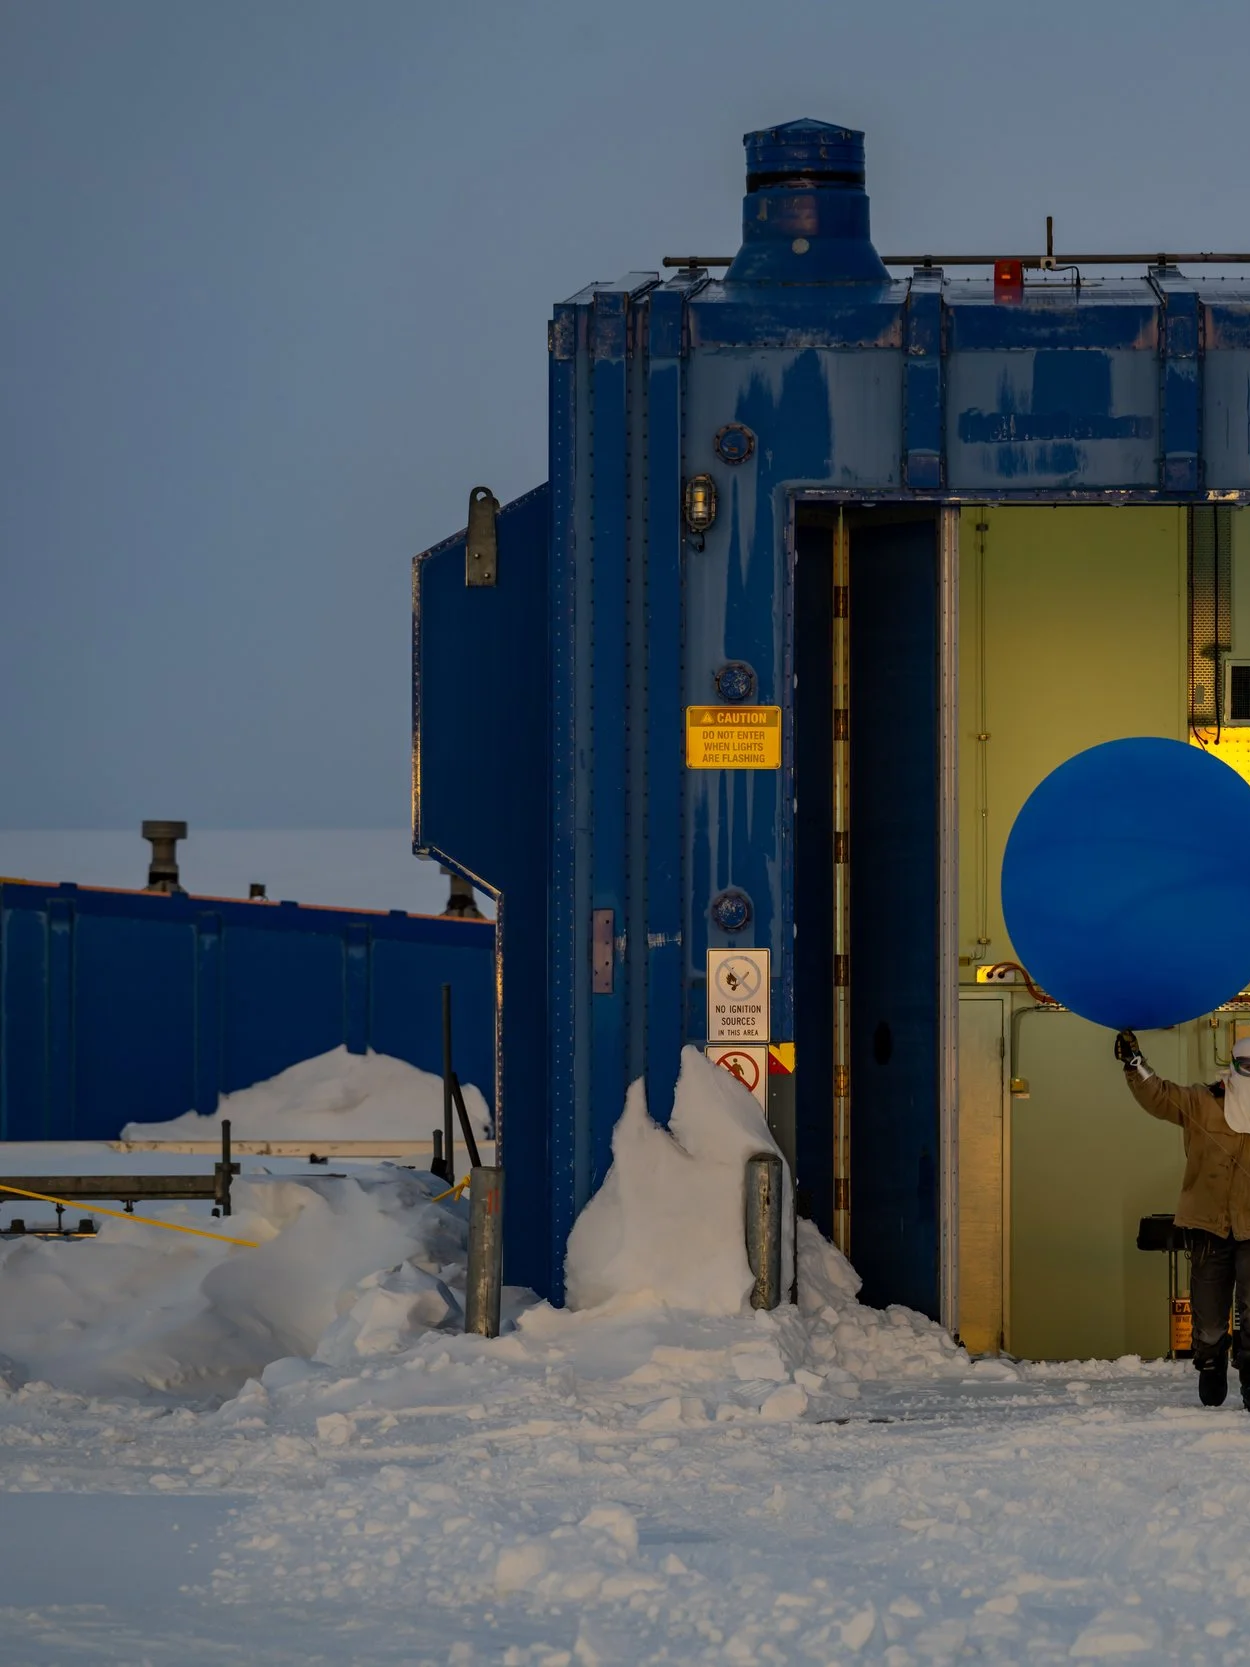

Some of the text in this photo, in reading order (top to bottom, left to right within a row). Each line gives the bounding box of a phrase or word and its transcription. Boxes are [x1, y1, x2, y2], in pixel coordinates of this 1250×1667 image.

[717, 712, 767, 724] CAUTION
[702, 730, 766, 740] DO NOT ENTER
[704, 742, 764, 751] WHEN LIGHTS
[702, 754, 766, 763] ARE FLASHING
[715, 1005, 762, 1014] NO IGNITION
[721, 1017, 756, 1026] SOURCES
